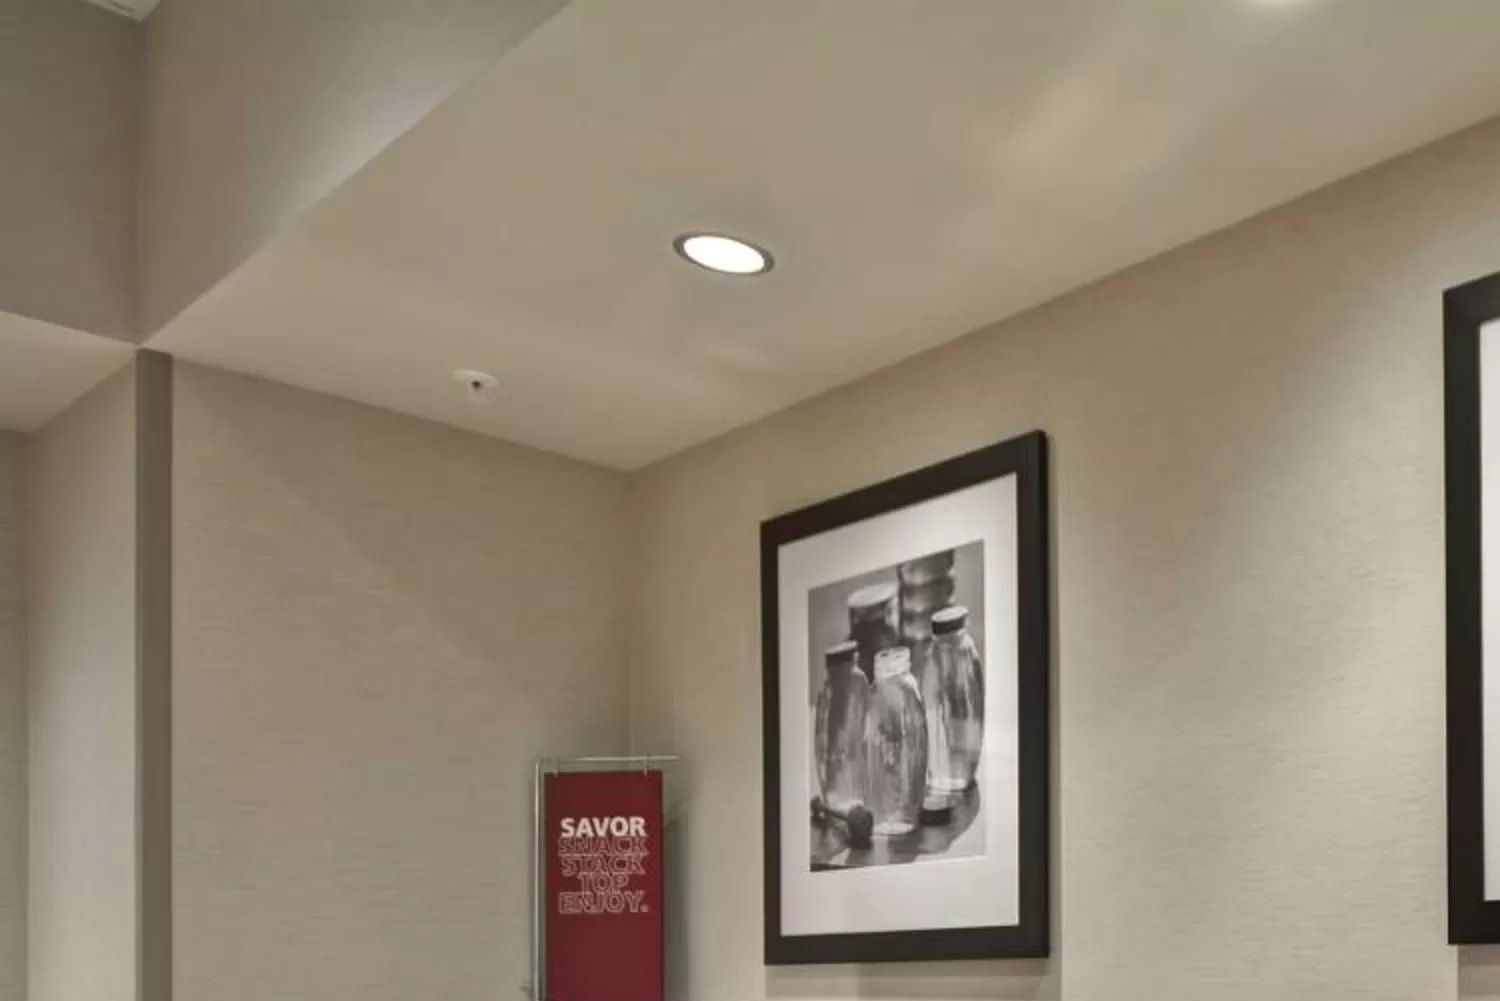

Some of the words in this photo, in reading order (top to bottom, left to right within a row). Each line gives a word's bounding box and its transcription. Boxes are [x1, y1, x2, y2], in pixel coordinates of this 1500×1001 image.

[560, 816, 648, 838] SAVOR
[577, 871, 629, 893] TOP
[558, 890, 648, 914] ENJOY.
